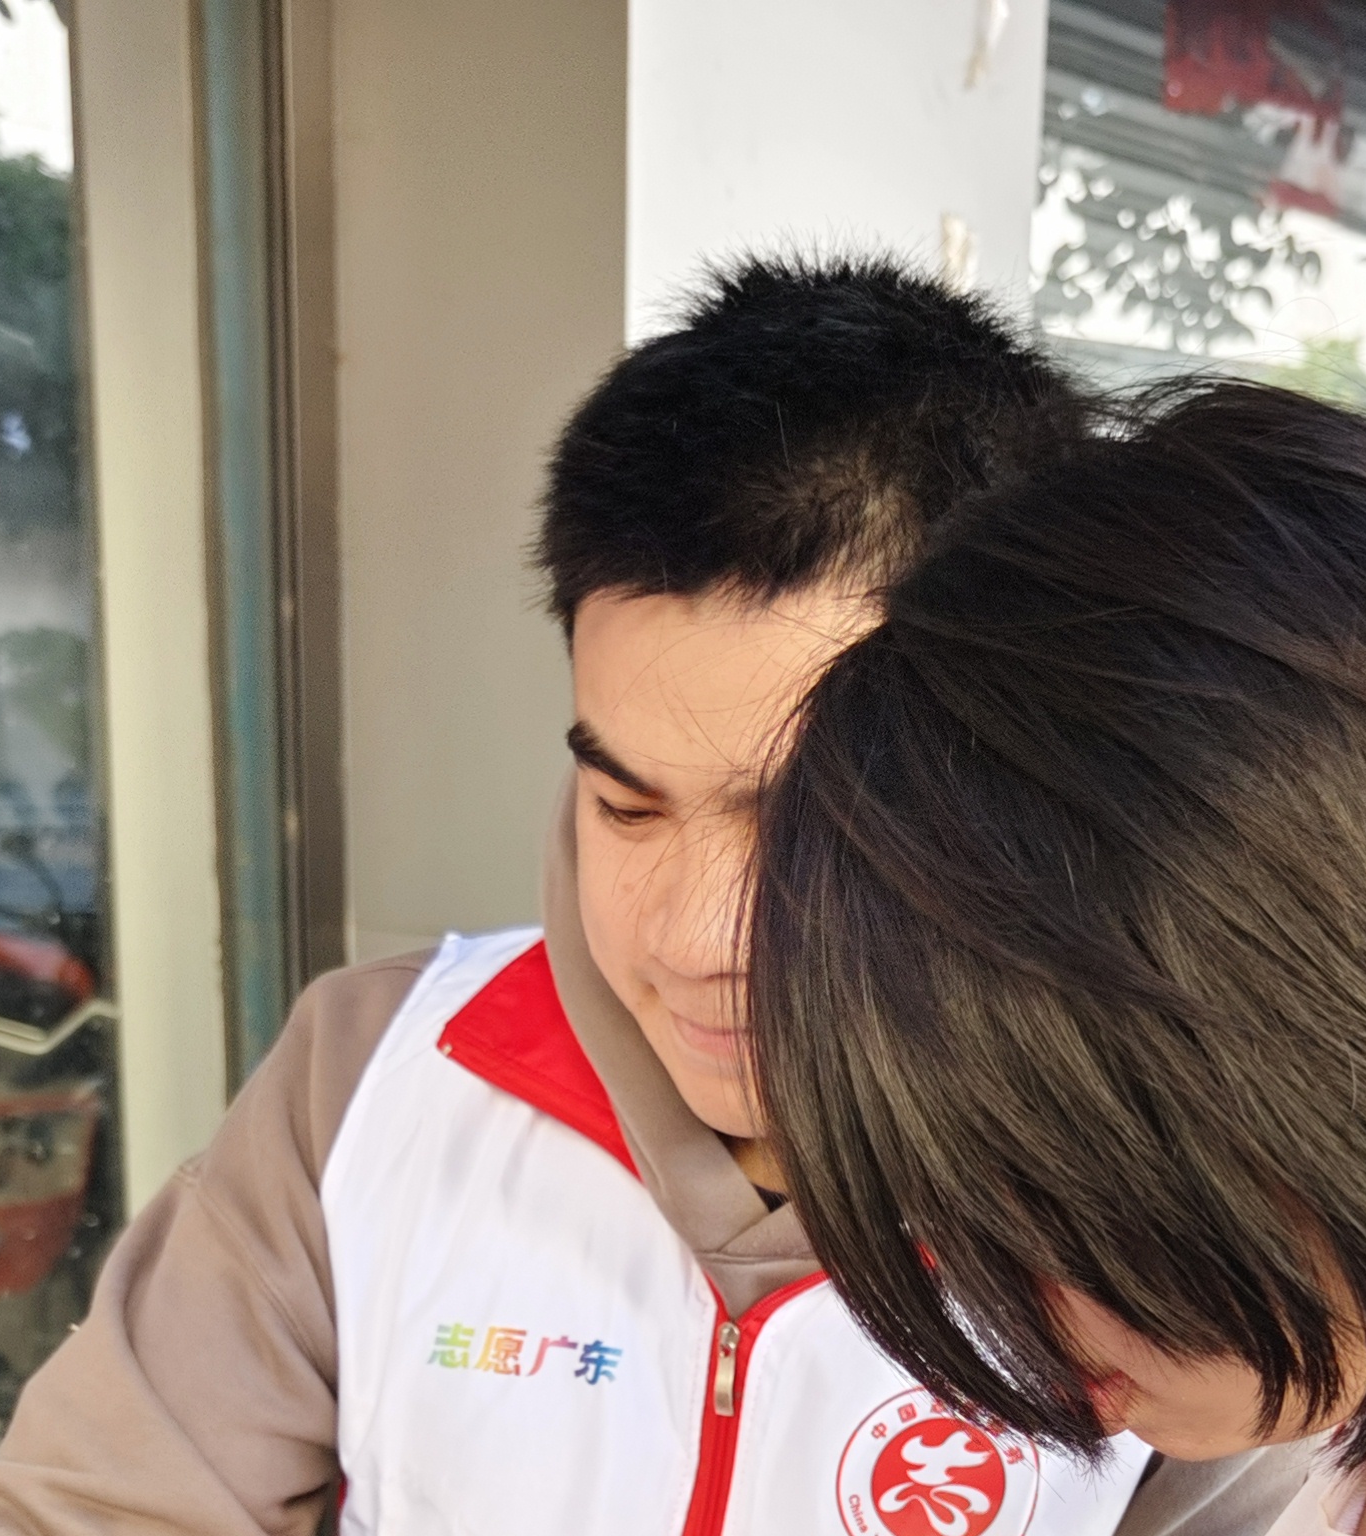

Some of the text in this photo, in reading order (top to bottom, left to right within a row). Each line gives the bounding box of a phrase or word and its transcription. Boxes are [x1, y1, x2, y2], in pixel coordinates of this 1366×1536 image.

[428, 1321, 625, 1385] 志愿广东
[847, 1493, 869, 1535] China
